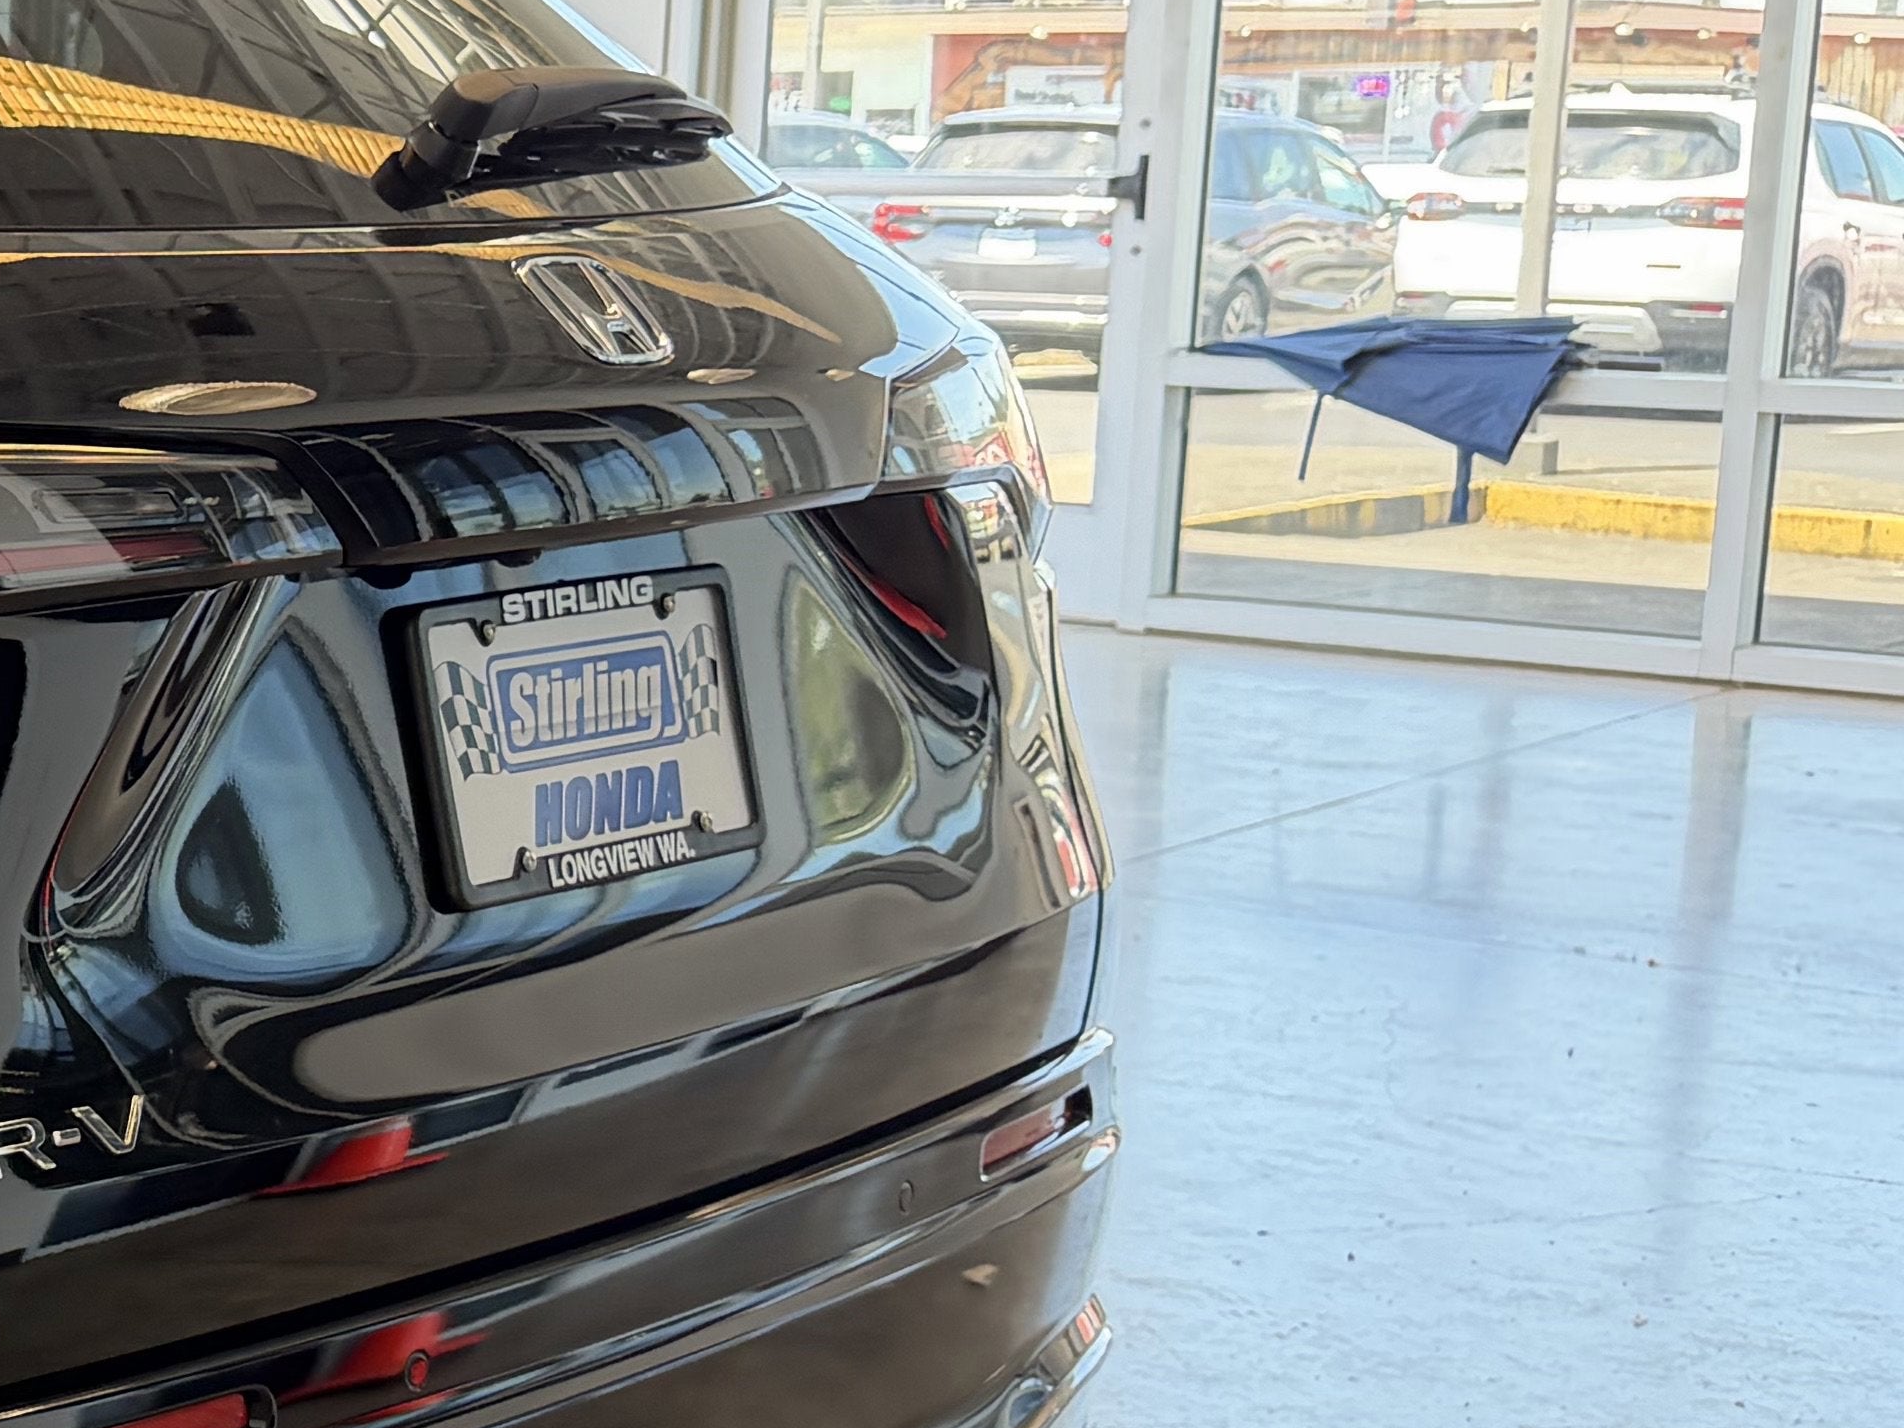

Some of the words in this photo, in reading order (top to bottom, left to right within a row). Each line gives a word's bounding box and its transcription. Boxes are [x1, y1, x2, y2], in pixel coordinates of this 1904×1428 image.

[502, 575, 653, 622] STIRLING
[508, 660, 662, 748] Stirling
[534, 759, 684, 848] HONDA
[547, 840, 655, 889] LONGVIEW
[655, 830, 696, 862] WA.
